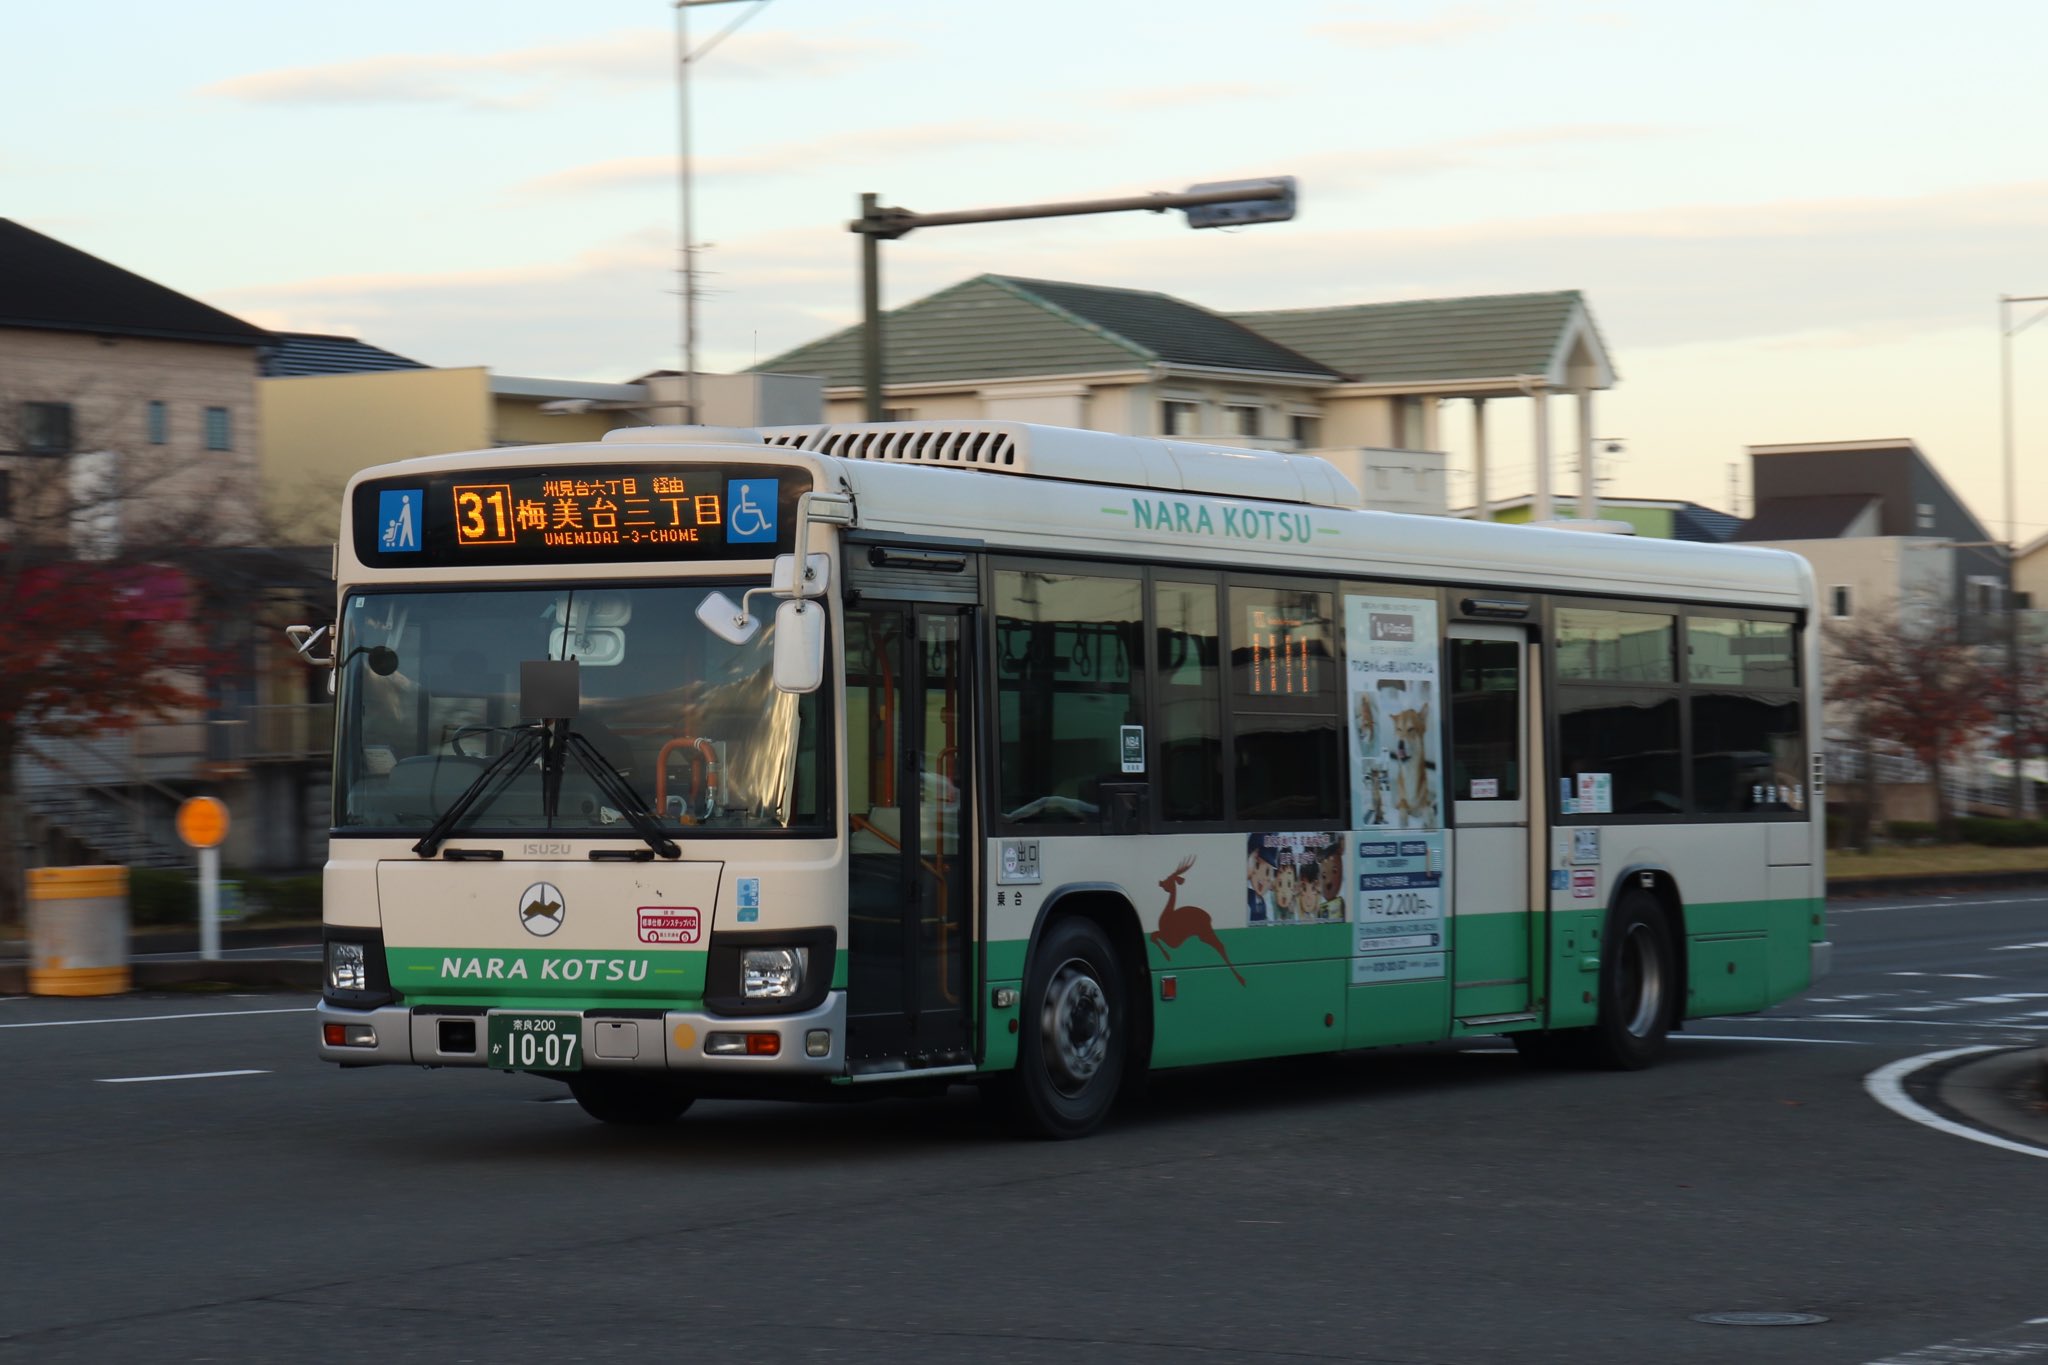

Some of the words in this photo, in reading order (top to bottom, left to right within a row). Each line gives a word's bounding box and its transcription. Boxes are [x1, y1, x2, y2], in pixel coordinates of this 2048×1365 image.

[543, 478, 637, 497] 州見台六丁目
[653, 476, 684, 494] 経由
[459, 491, 505, 539] 31
[516, 495, 721, 530] 梅美台三丁目
[1131, 498, 1215, 536] NARA
[1223, 507, 1312, 544] KOTSU
[544, 529, 699, 546] UMEMIDAI-3-CHOME
[523, 844, 572, 855] ISUZU
[1017, 840, 1037, 862] 出口
[440, 956, 529, 981] NARA
[541, 957, 649, 982] KOTSU
[492, 1043, 502, 1055] か
[508, 1033, 577, 1067] 10-07
